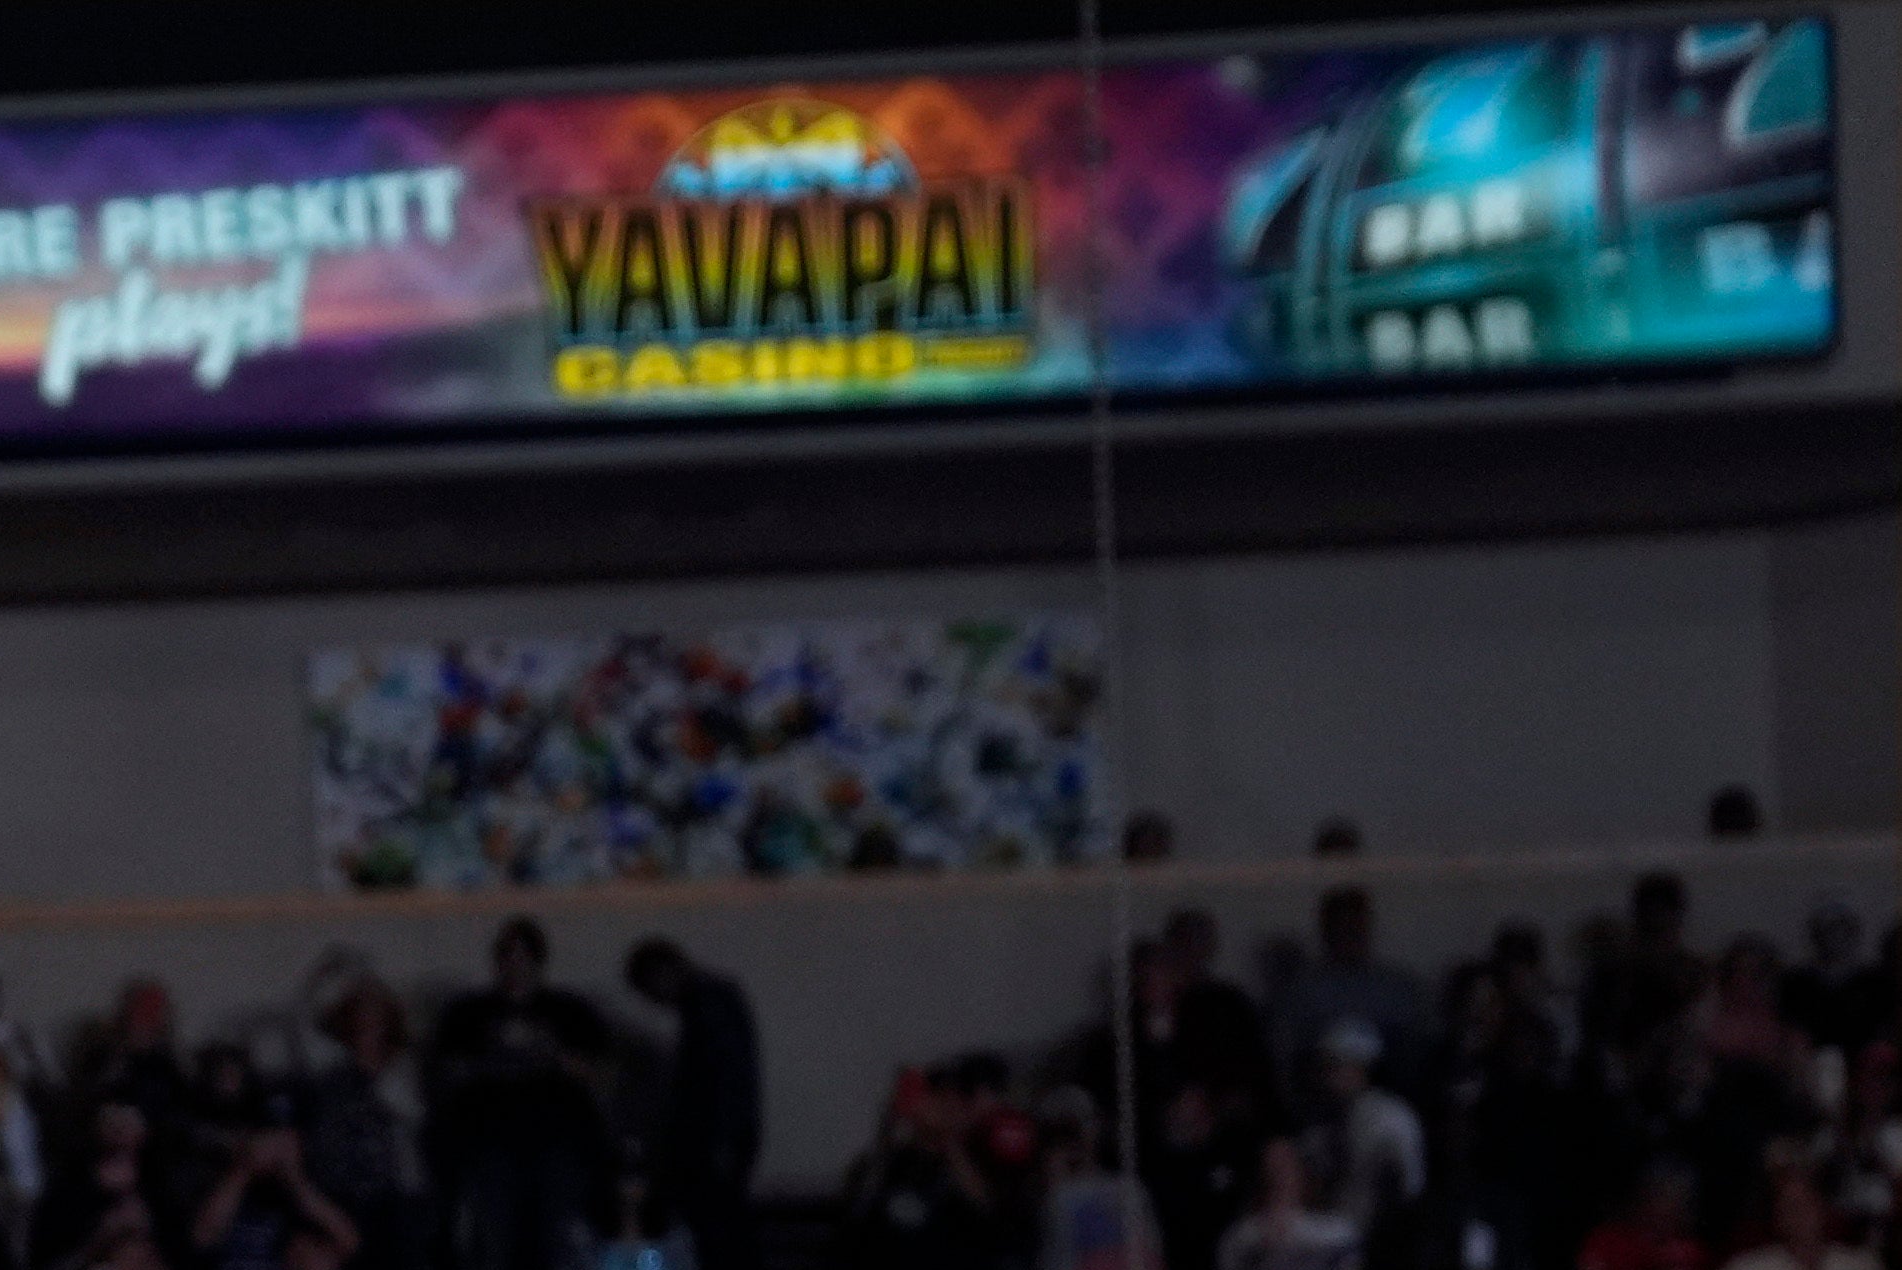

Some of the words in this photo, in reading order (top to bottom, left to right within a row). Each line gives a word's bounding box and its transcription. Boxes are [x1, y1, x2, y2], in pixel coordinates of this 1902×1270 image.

[99, 163, 466, 268] PRESKITT
[541, 184, 1032, 338] YAVAPAI
[554, 333, 916, 397] CASINO
